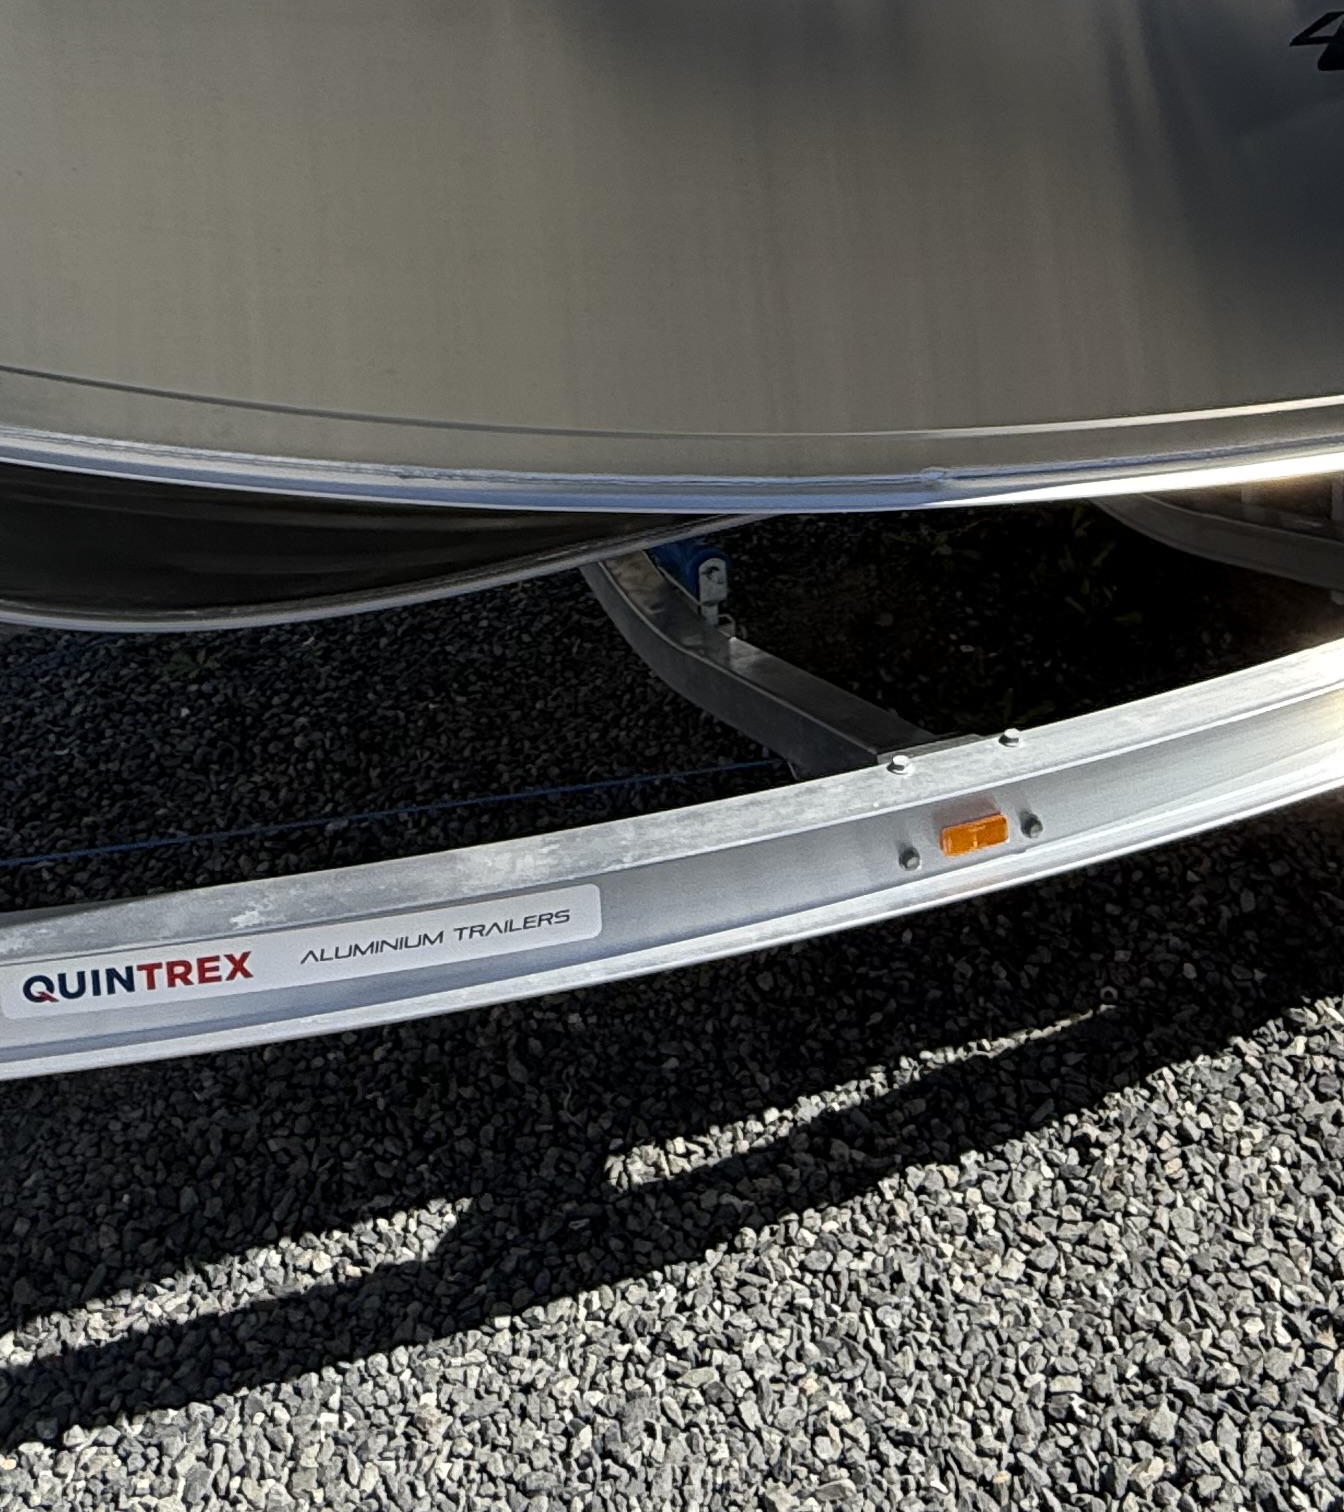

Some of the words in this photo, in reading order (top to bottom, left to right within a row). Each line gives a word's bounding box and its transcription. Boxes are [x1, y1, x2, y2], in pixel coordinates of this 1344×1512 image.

[21, 950, 254, 1004] QUINTREX
[300, 930, 444, 965] ALUMINIUM
[454, 908, 571, 942] TRAILERS
